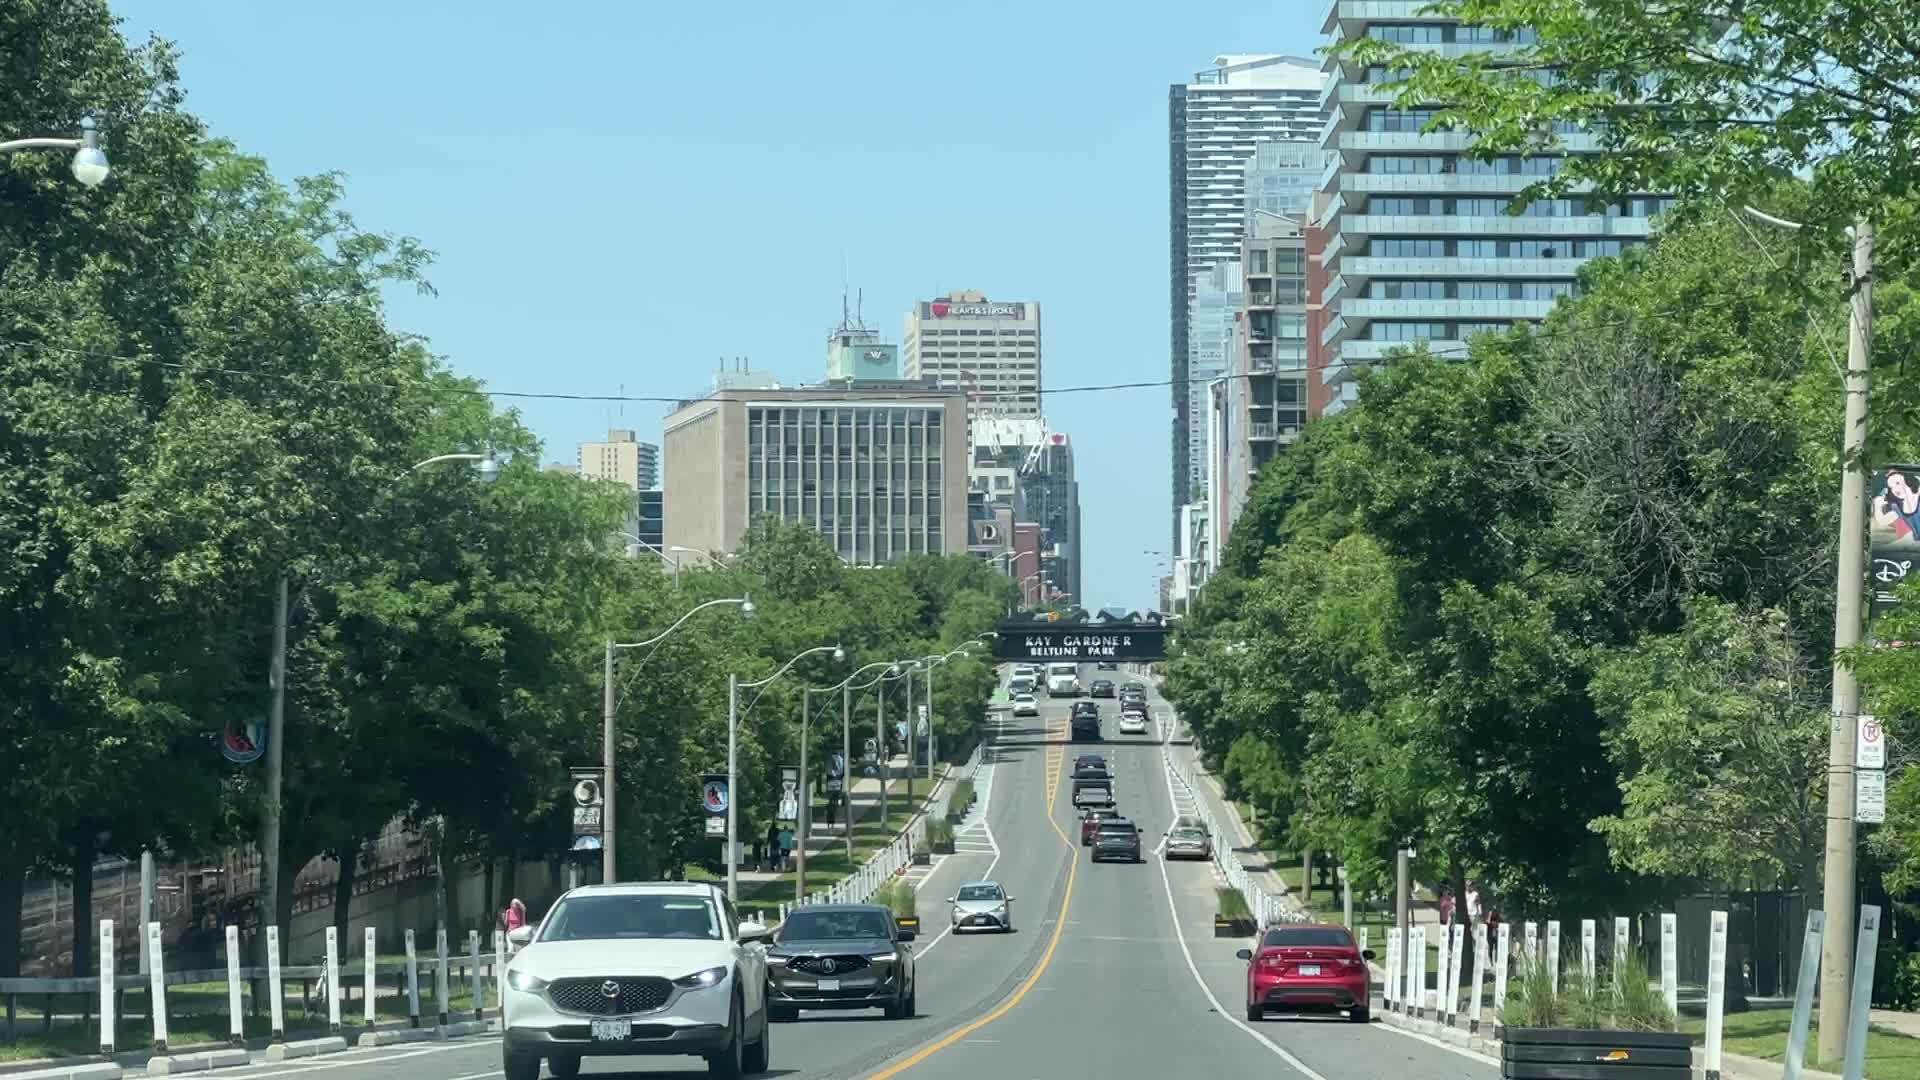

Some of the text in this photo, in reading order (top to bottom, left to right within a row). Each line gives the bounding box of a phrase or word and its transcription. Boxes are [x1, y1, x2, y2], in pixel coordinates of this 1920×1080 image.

[1025, 635, 1132, 647] KAY GARDNER
[1030, 646, 1115, 657] BELTLINE PARK
